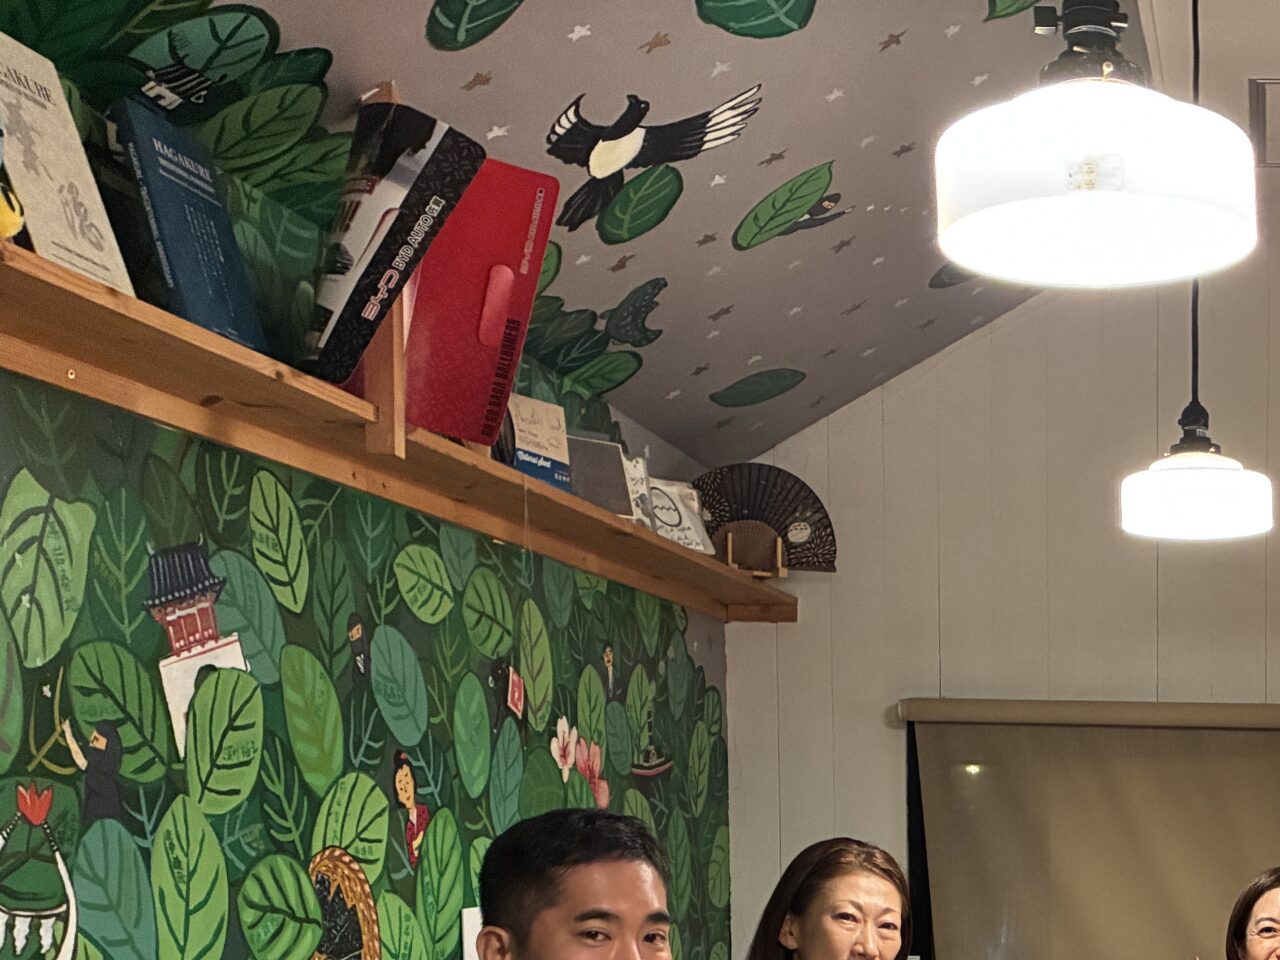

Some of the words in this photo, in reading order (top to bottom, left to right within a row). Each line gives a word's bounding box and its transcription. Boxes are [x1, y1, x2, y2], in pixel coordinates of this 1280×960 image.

[152, 137, 213, 182] HAGAKURE
[392, 244, 414, 271] BYD
[407, 211, 435, 248] AUTO
